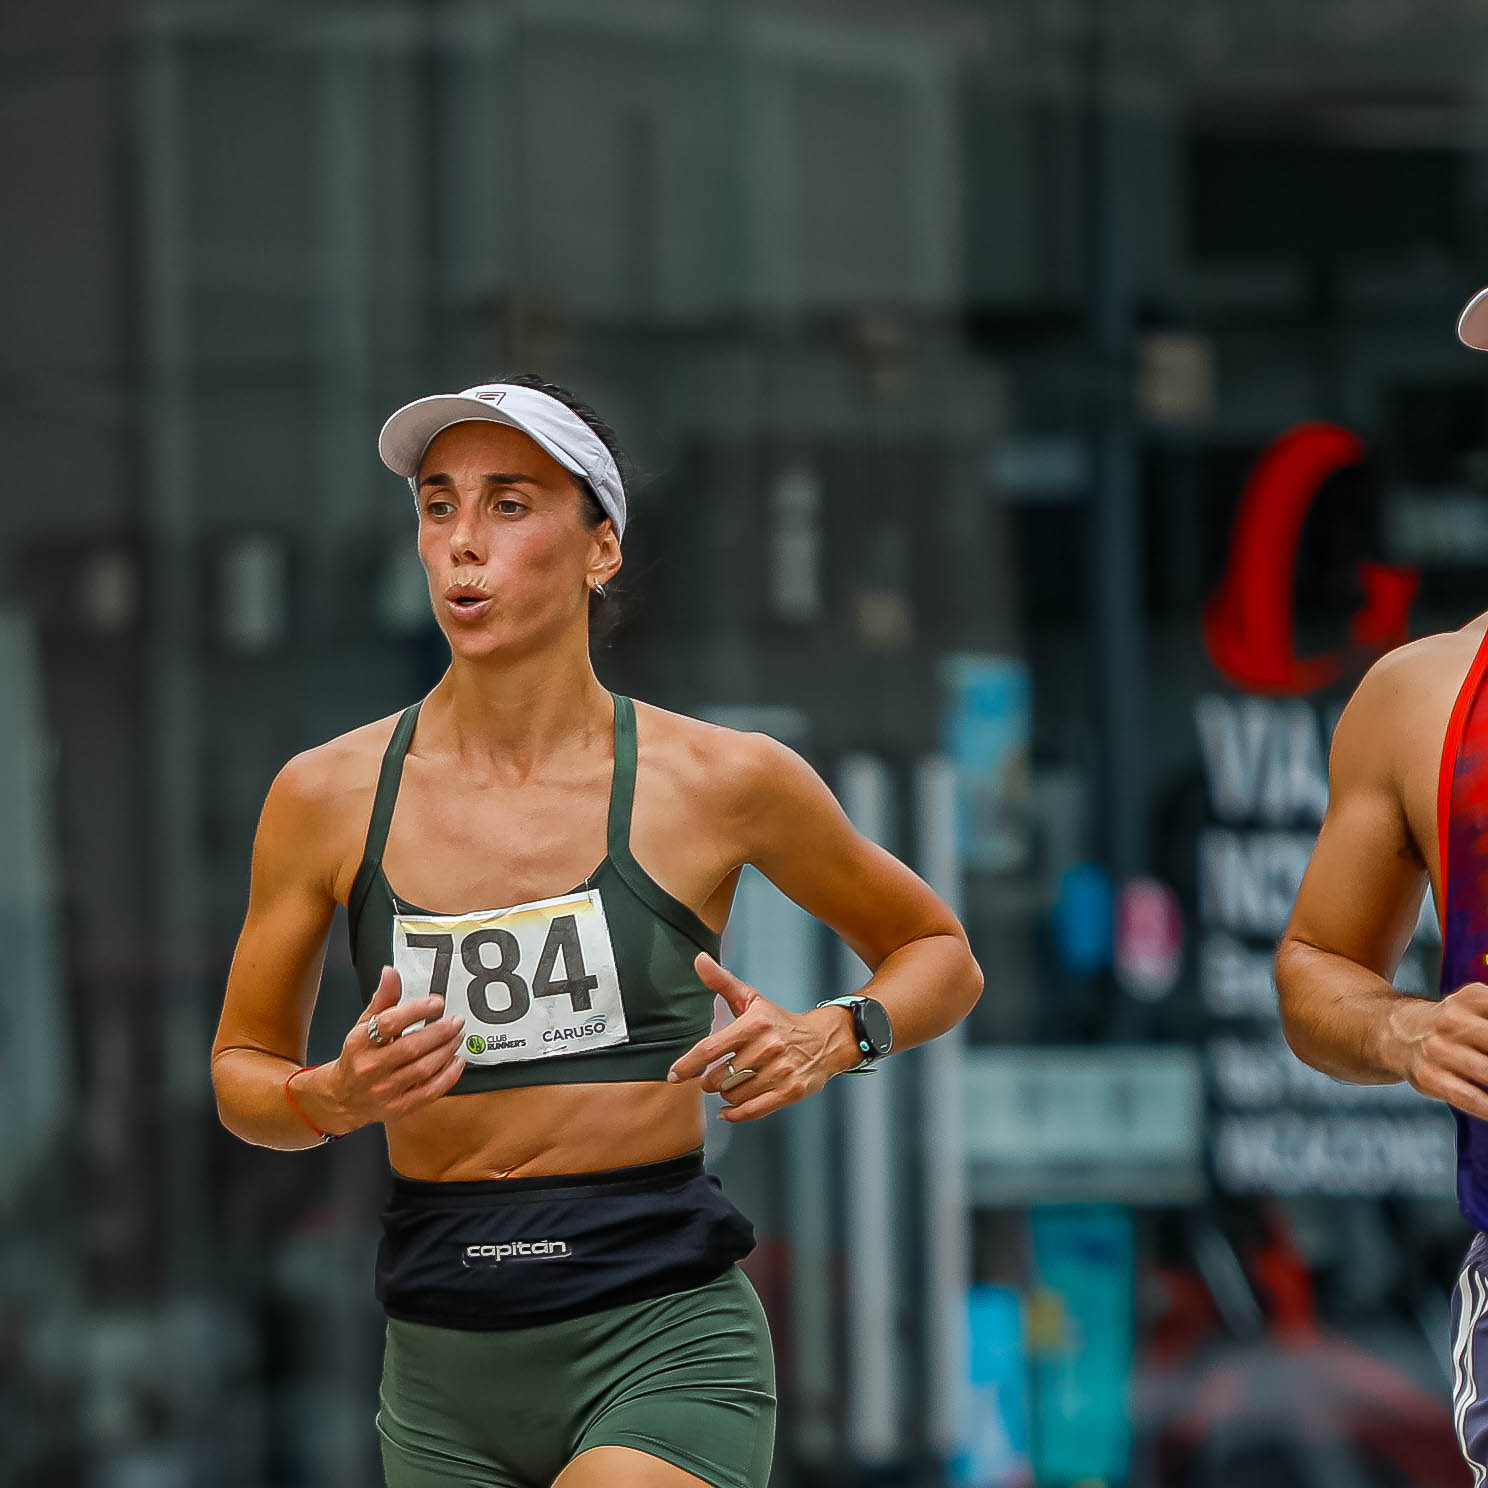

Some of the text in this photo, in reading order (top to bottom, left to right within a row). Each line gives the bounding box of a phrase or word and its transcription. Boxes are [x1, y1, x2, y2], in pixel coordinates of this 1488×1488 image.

[406, 914, 598, 1025] 784
[486, 1034, 508, 1043] CLUB
[542, 1022, 606, 1042] CARUSO
